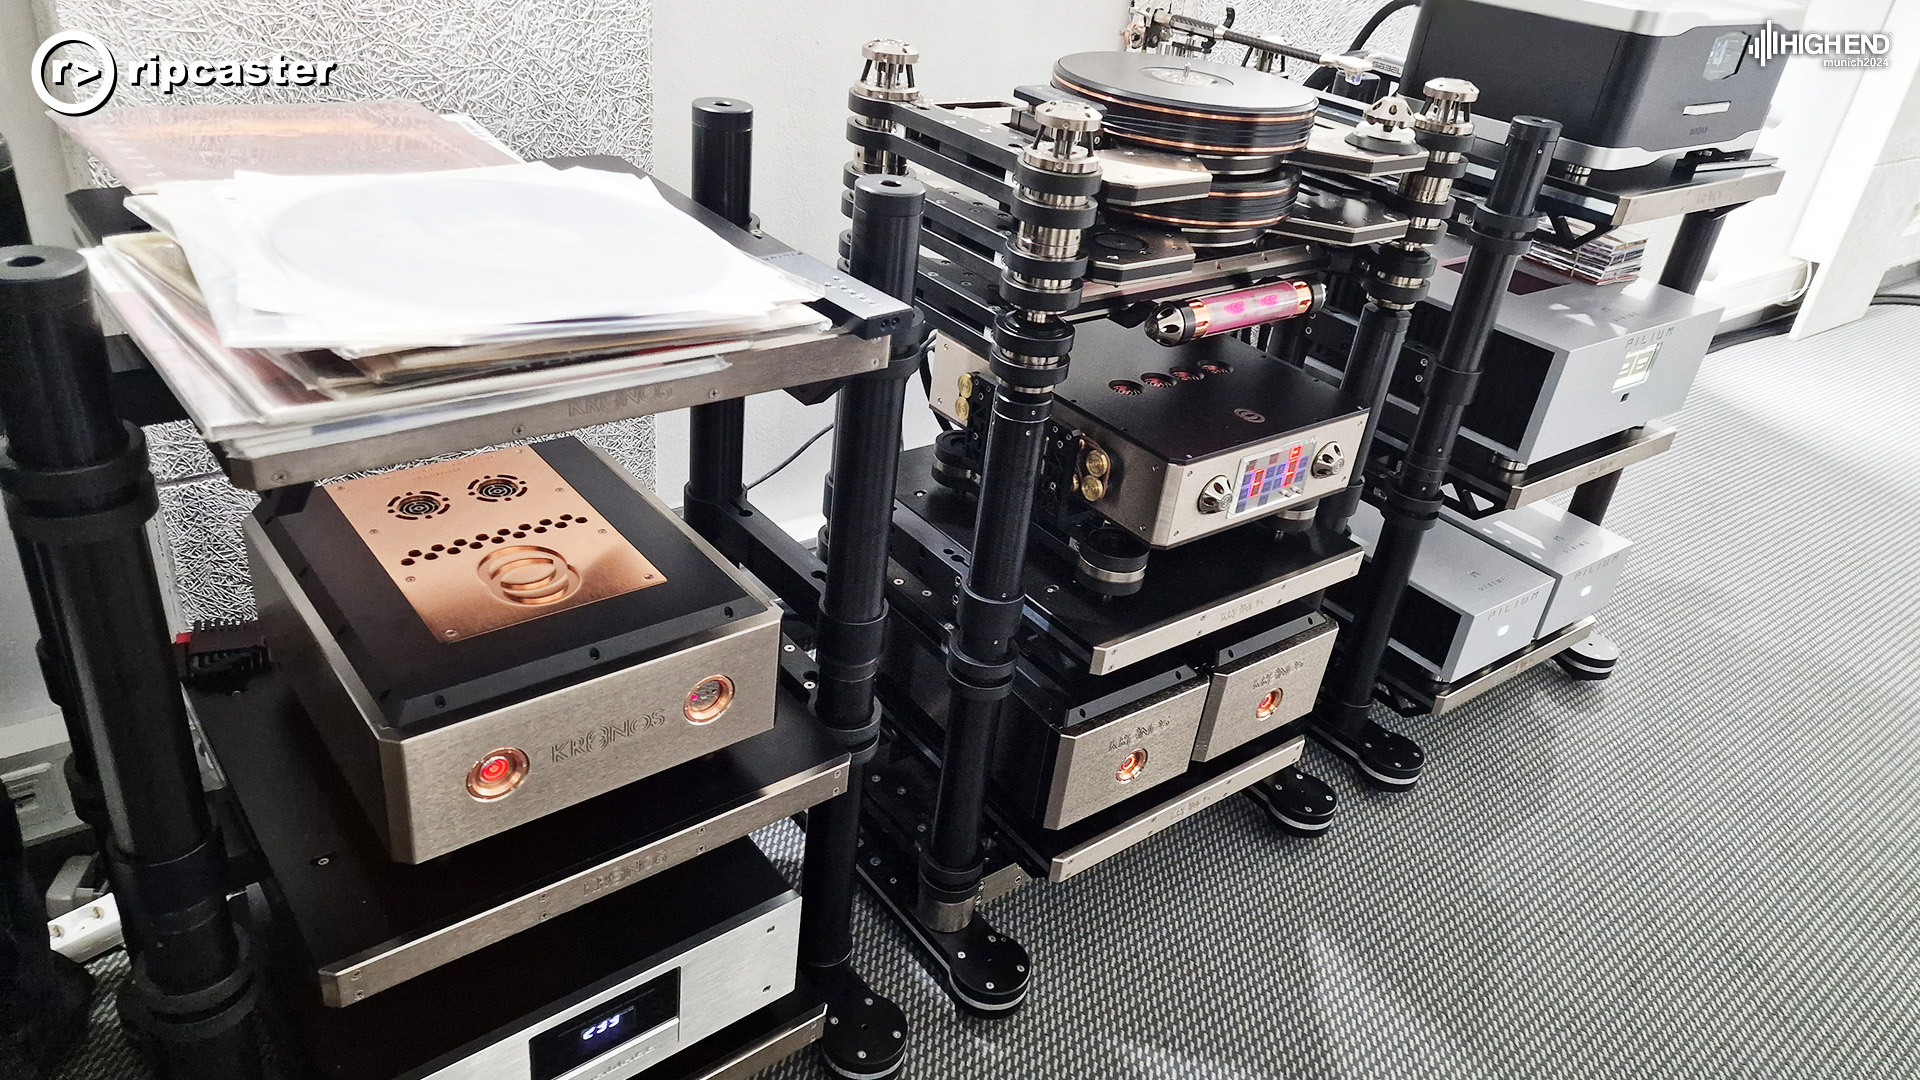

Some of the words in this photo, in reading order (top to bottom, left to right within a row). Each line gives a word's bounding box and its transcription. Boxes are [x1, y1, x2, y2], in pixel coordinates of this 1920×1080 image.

[1625, 327, 1674, 349] PILIUM
[567, 384, 672, 417] KRONOS
[1574, 553, 1620, 580] PILIUM
[1487, 590, 1540, 620] PILIUM
[551, 709, 666, 763] KRONOS
